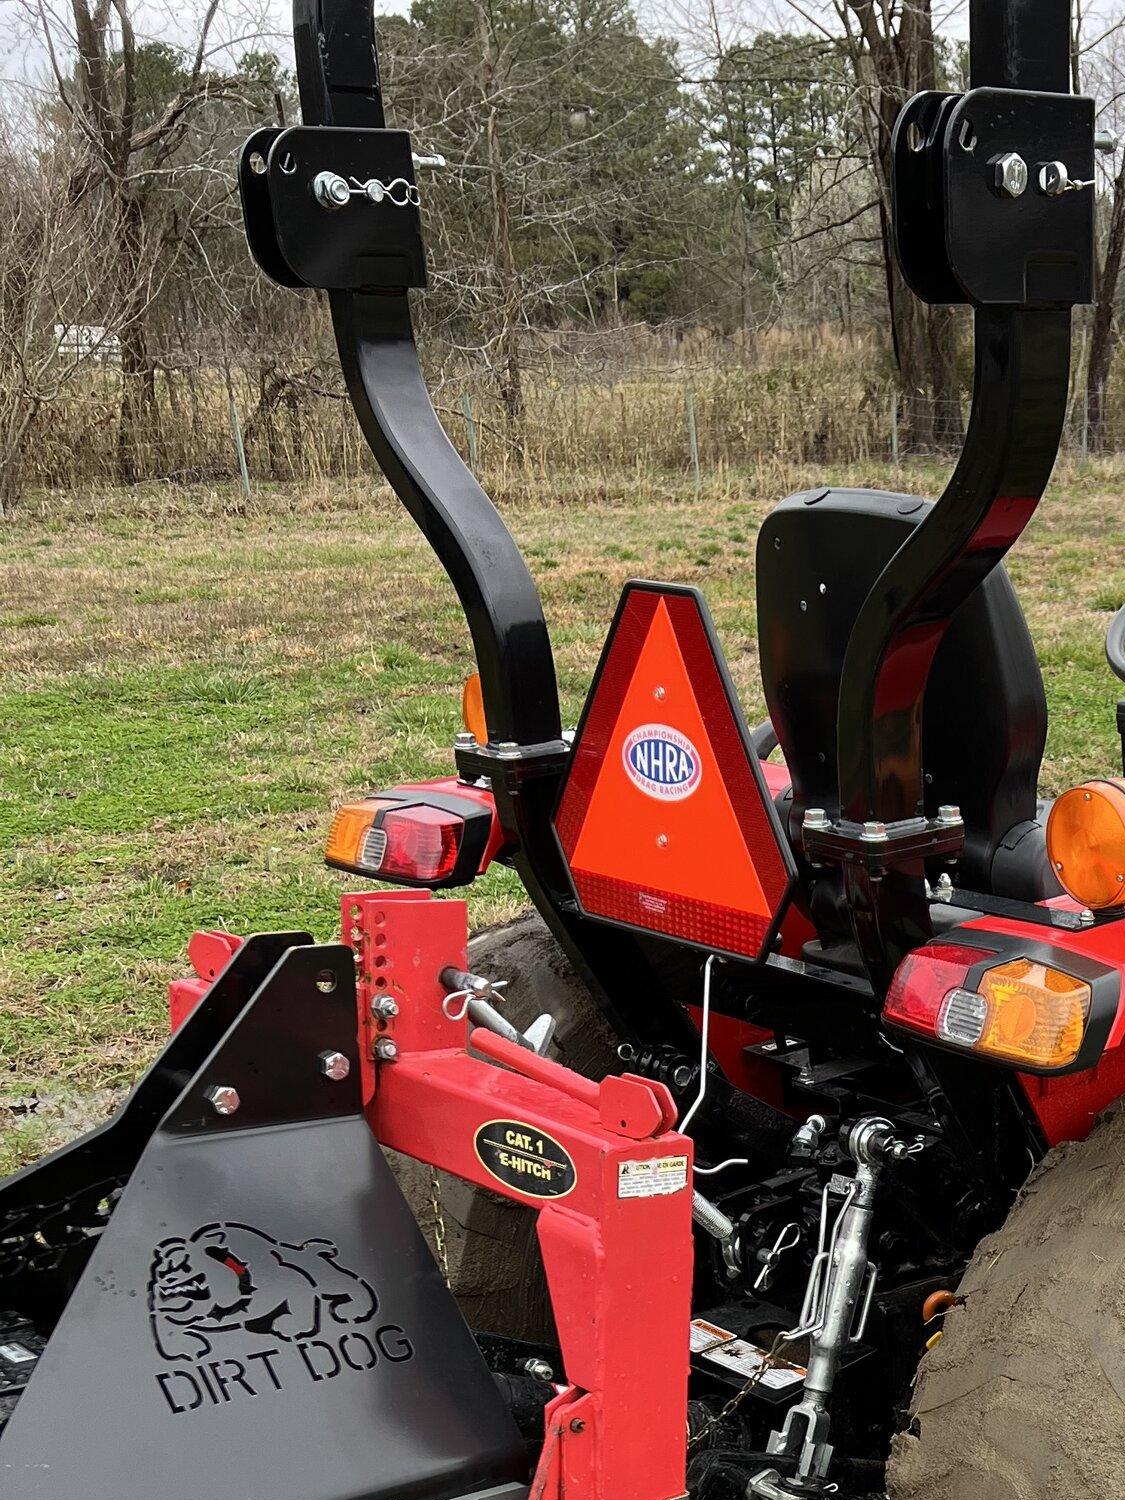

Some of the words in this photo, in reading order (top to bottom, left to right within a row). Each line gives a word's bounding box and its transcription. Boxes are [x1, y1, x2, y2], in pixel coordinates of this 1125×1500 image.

[633, 729, 691, 751] CHAMPIONSHIP
[636, 741, 690, 782] NHRA
[636, 774, 657, 791] DRAG
[660, 783, 688, 795] RACING
[506, 1130, 534, 1151] CAT.
[536, 1140, 543, 1154] 1
[499, 1152, 551, 1181] E-HITCH
[155, 1348, 283, 1415] DIRT
[297, 1324, 415, 1383] DOG
